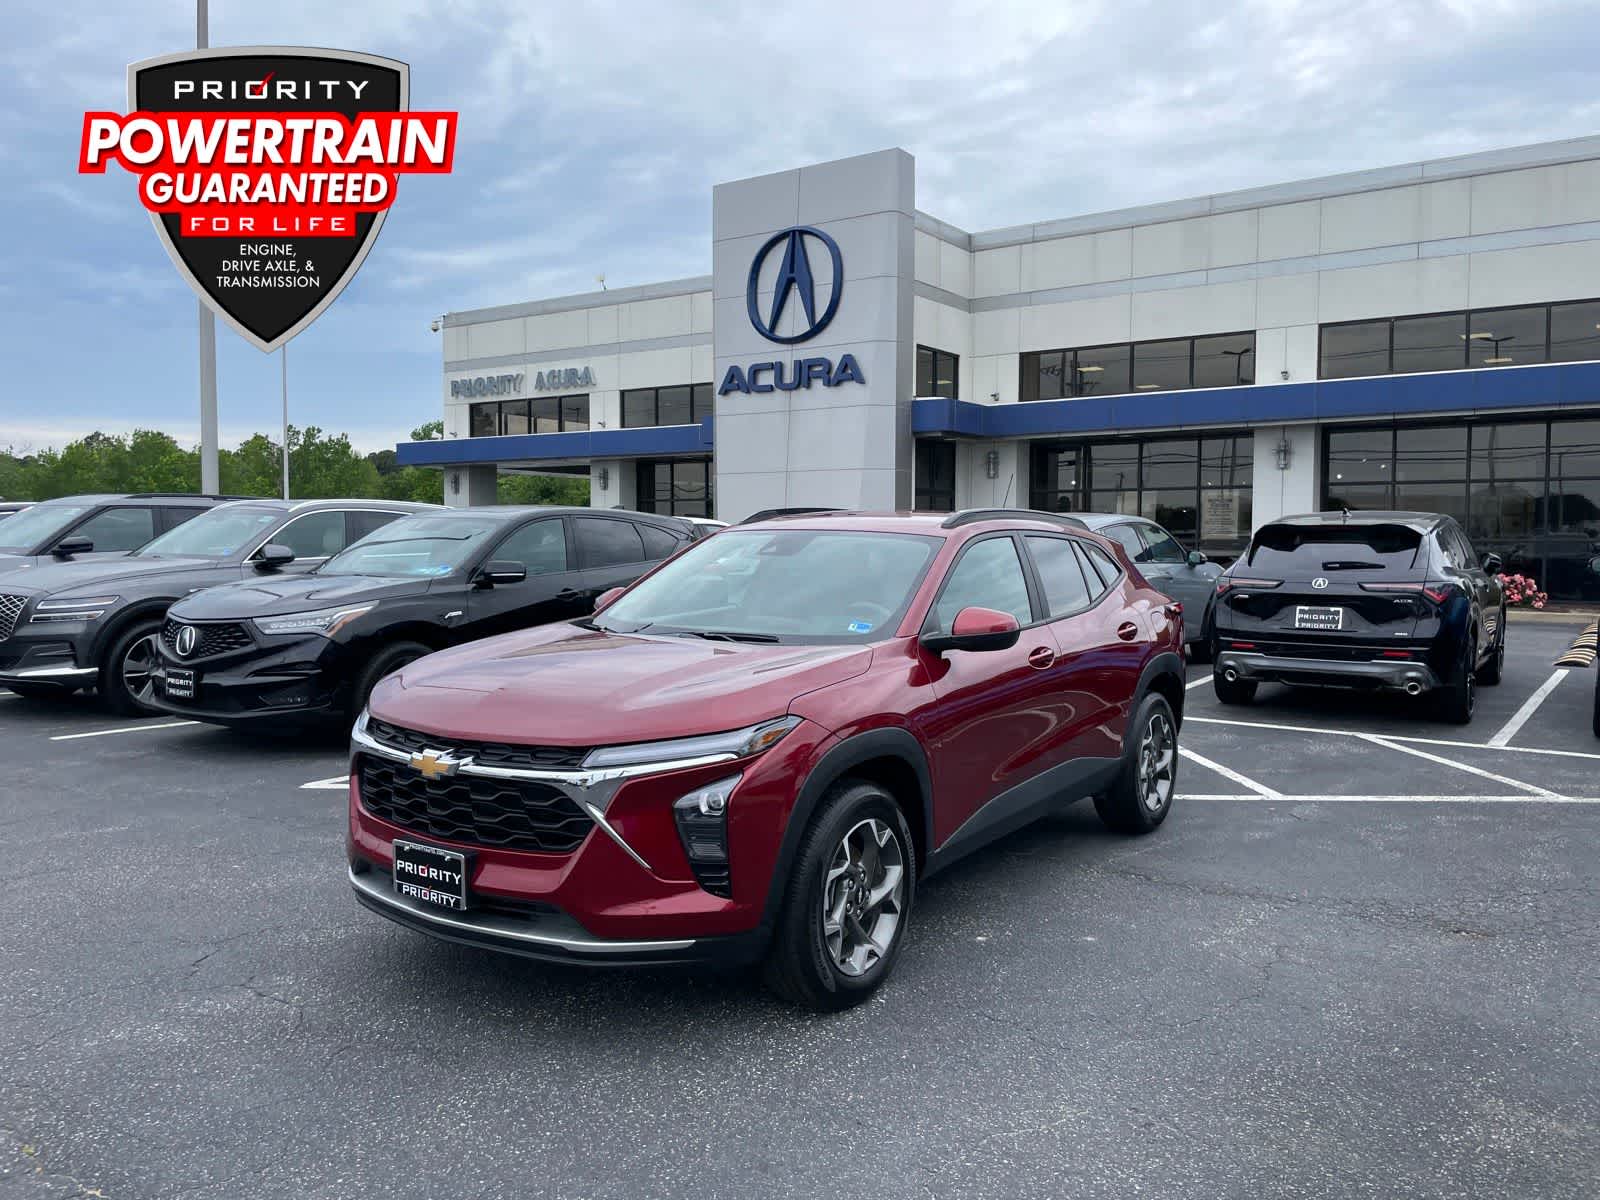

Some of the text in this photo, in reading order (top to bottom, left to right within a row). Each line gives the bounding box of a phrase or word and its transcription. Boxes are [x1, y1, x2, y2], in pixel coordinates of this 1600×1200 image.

[451, 366, 596, 398] PRIORITY ACURA
[718, 354, 866, 397] ACURA
[1298, 613, 1340, 621] PRIORITY
[396, 859, 461, 885] PRIORITY
[402, 885, 456, 907] PRIORITY
